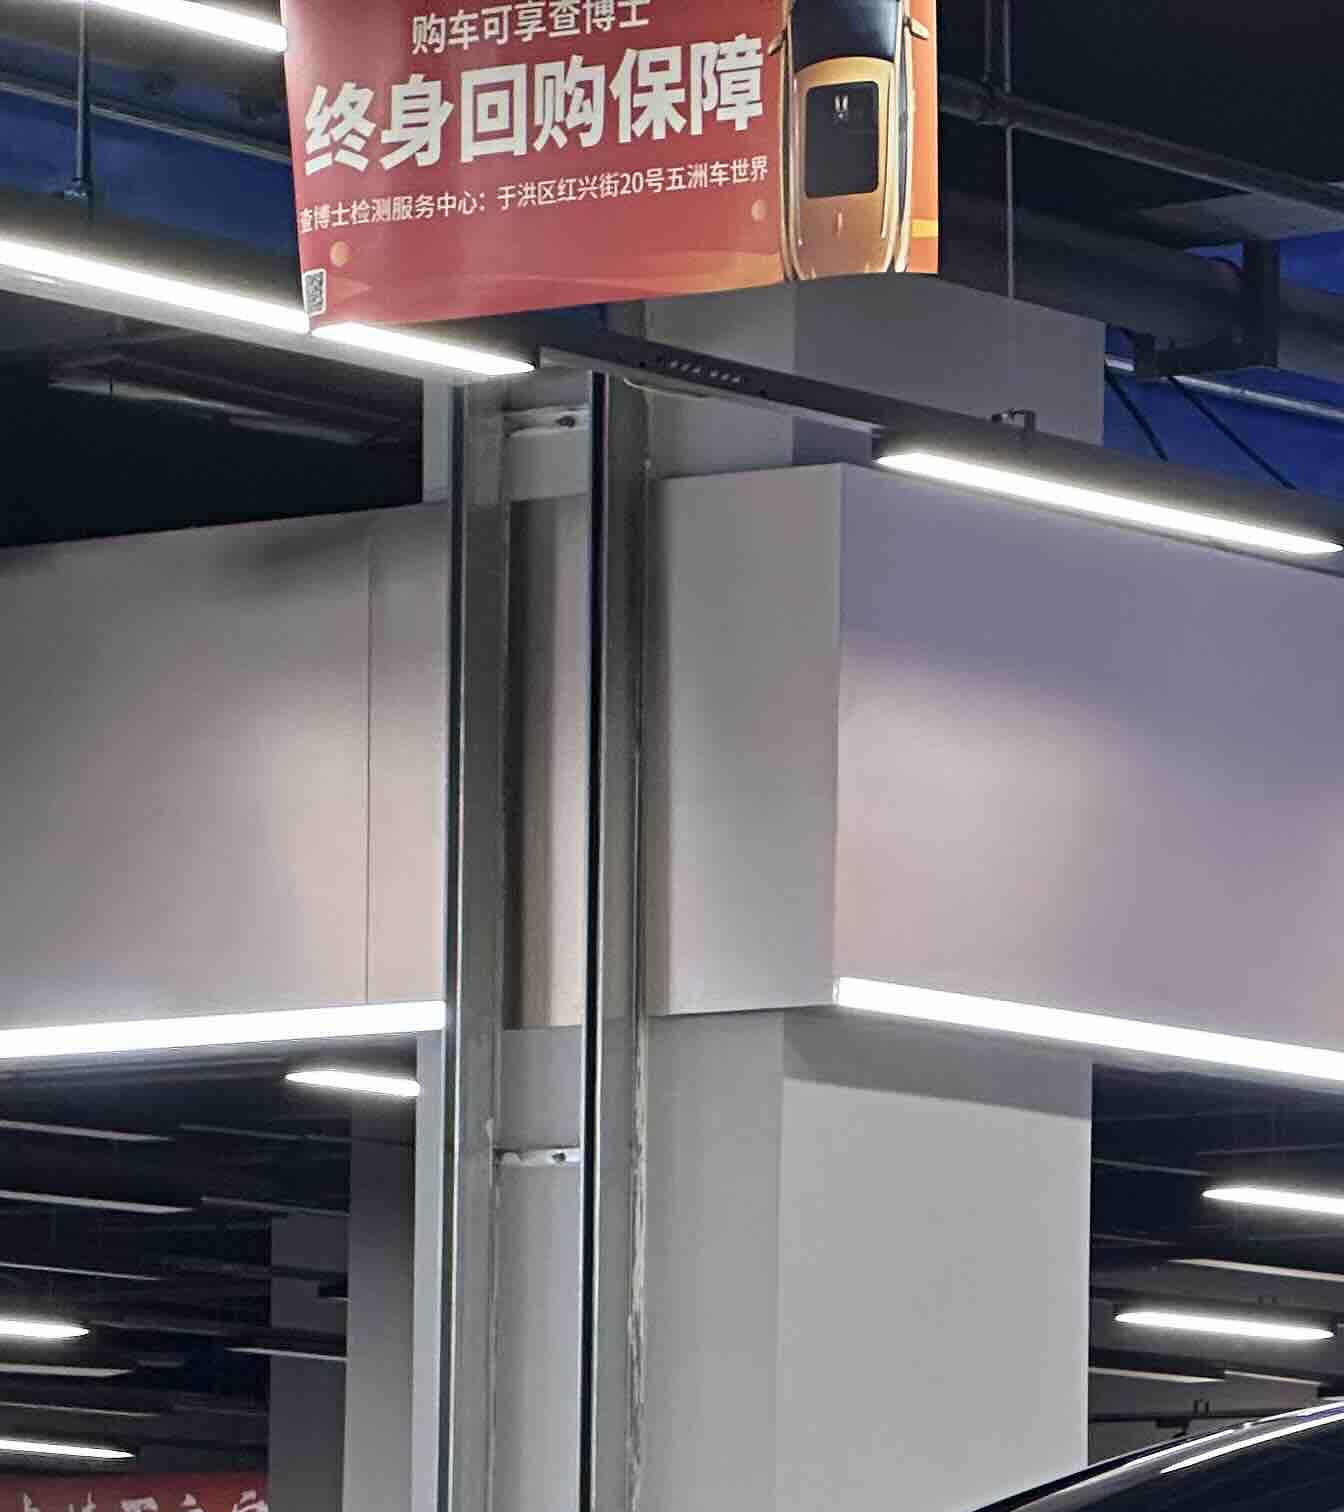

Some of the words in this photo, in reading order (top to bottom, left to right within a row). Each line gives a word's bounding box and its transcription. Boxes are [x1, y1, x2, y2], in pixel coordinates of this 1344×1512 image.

[412, 0, 648, 55] 购车可享查博士
[305, 33, 765, 177] 终身回购保障
